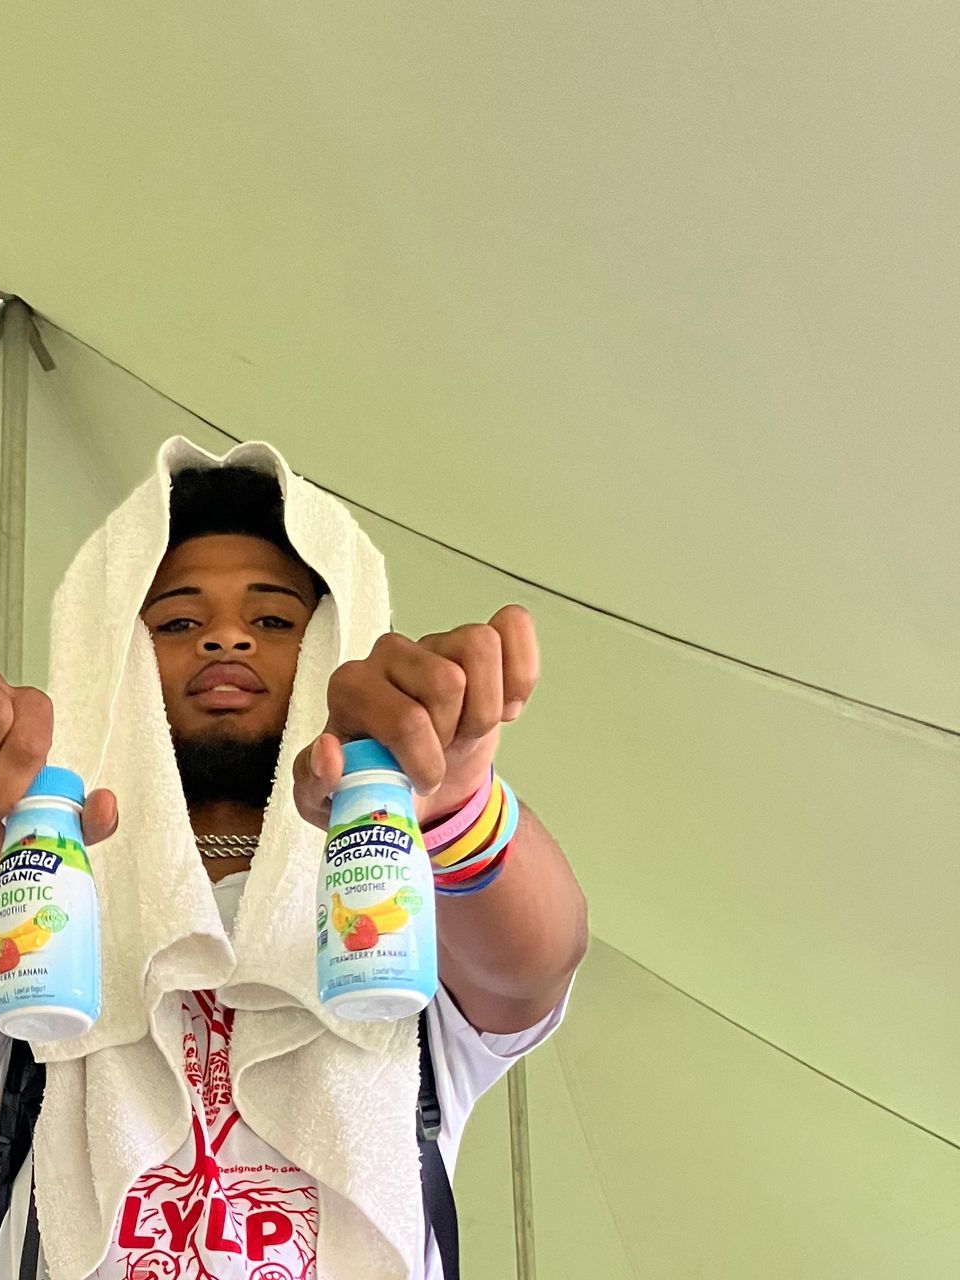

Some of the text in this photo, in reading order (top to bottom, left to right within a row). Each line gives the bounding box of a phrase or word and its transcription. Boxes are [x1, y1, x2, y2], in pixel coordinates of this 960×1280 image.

[329, 826, 411, 857] Stonyfield
[334, 847, 400, 867] ORGANIC
[326, 865, 410, 891] PROBIOTIC
[345, 882, 386, 895] SMOOTHIE
[330, 951, 374, 966] STRAWBERRY
[18, 968, 48, 977] BANANA
[218, 1165, 262, 1174] Designed
[118, 1196, 293, 1261] LYLP
